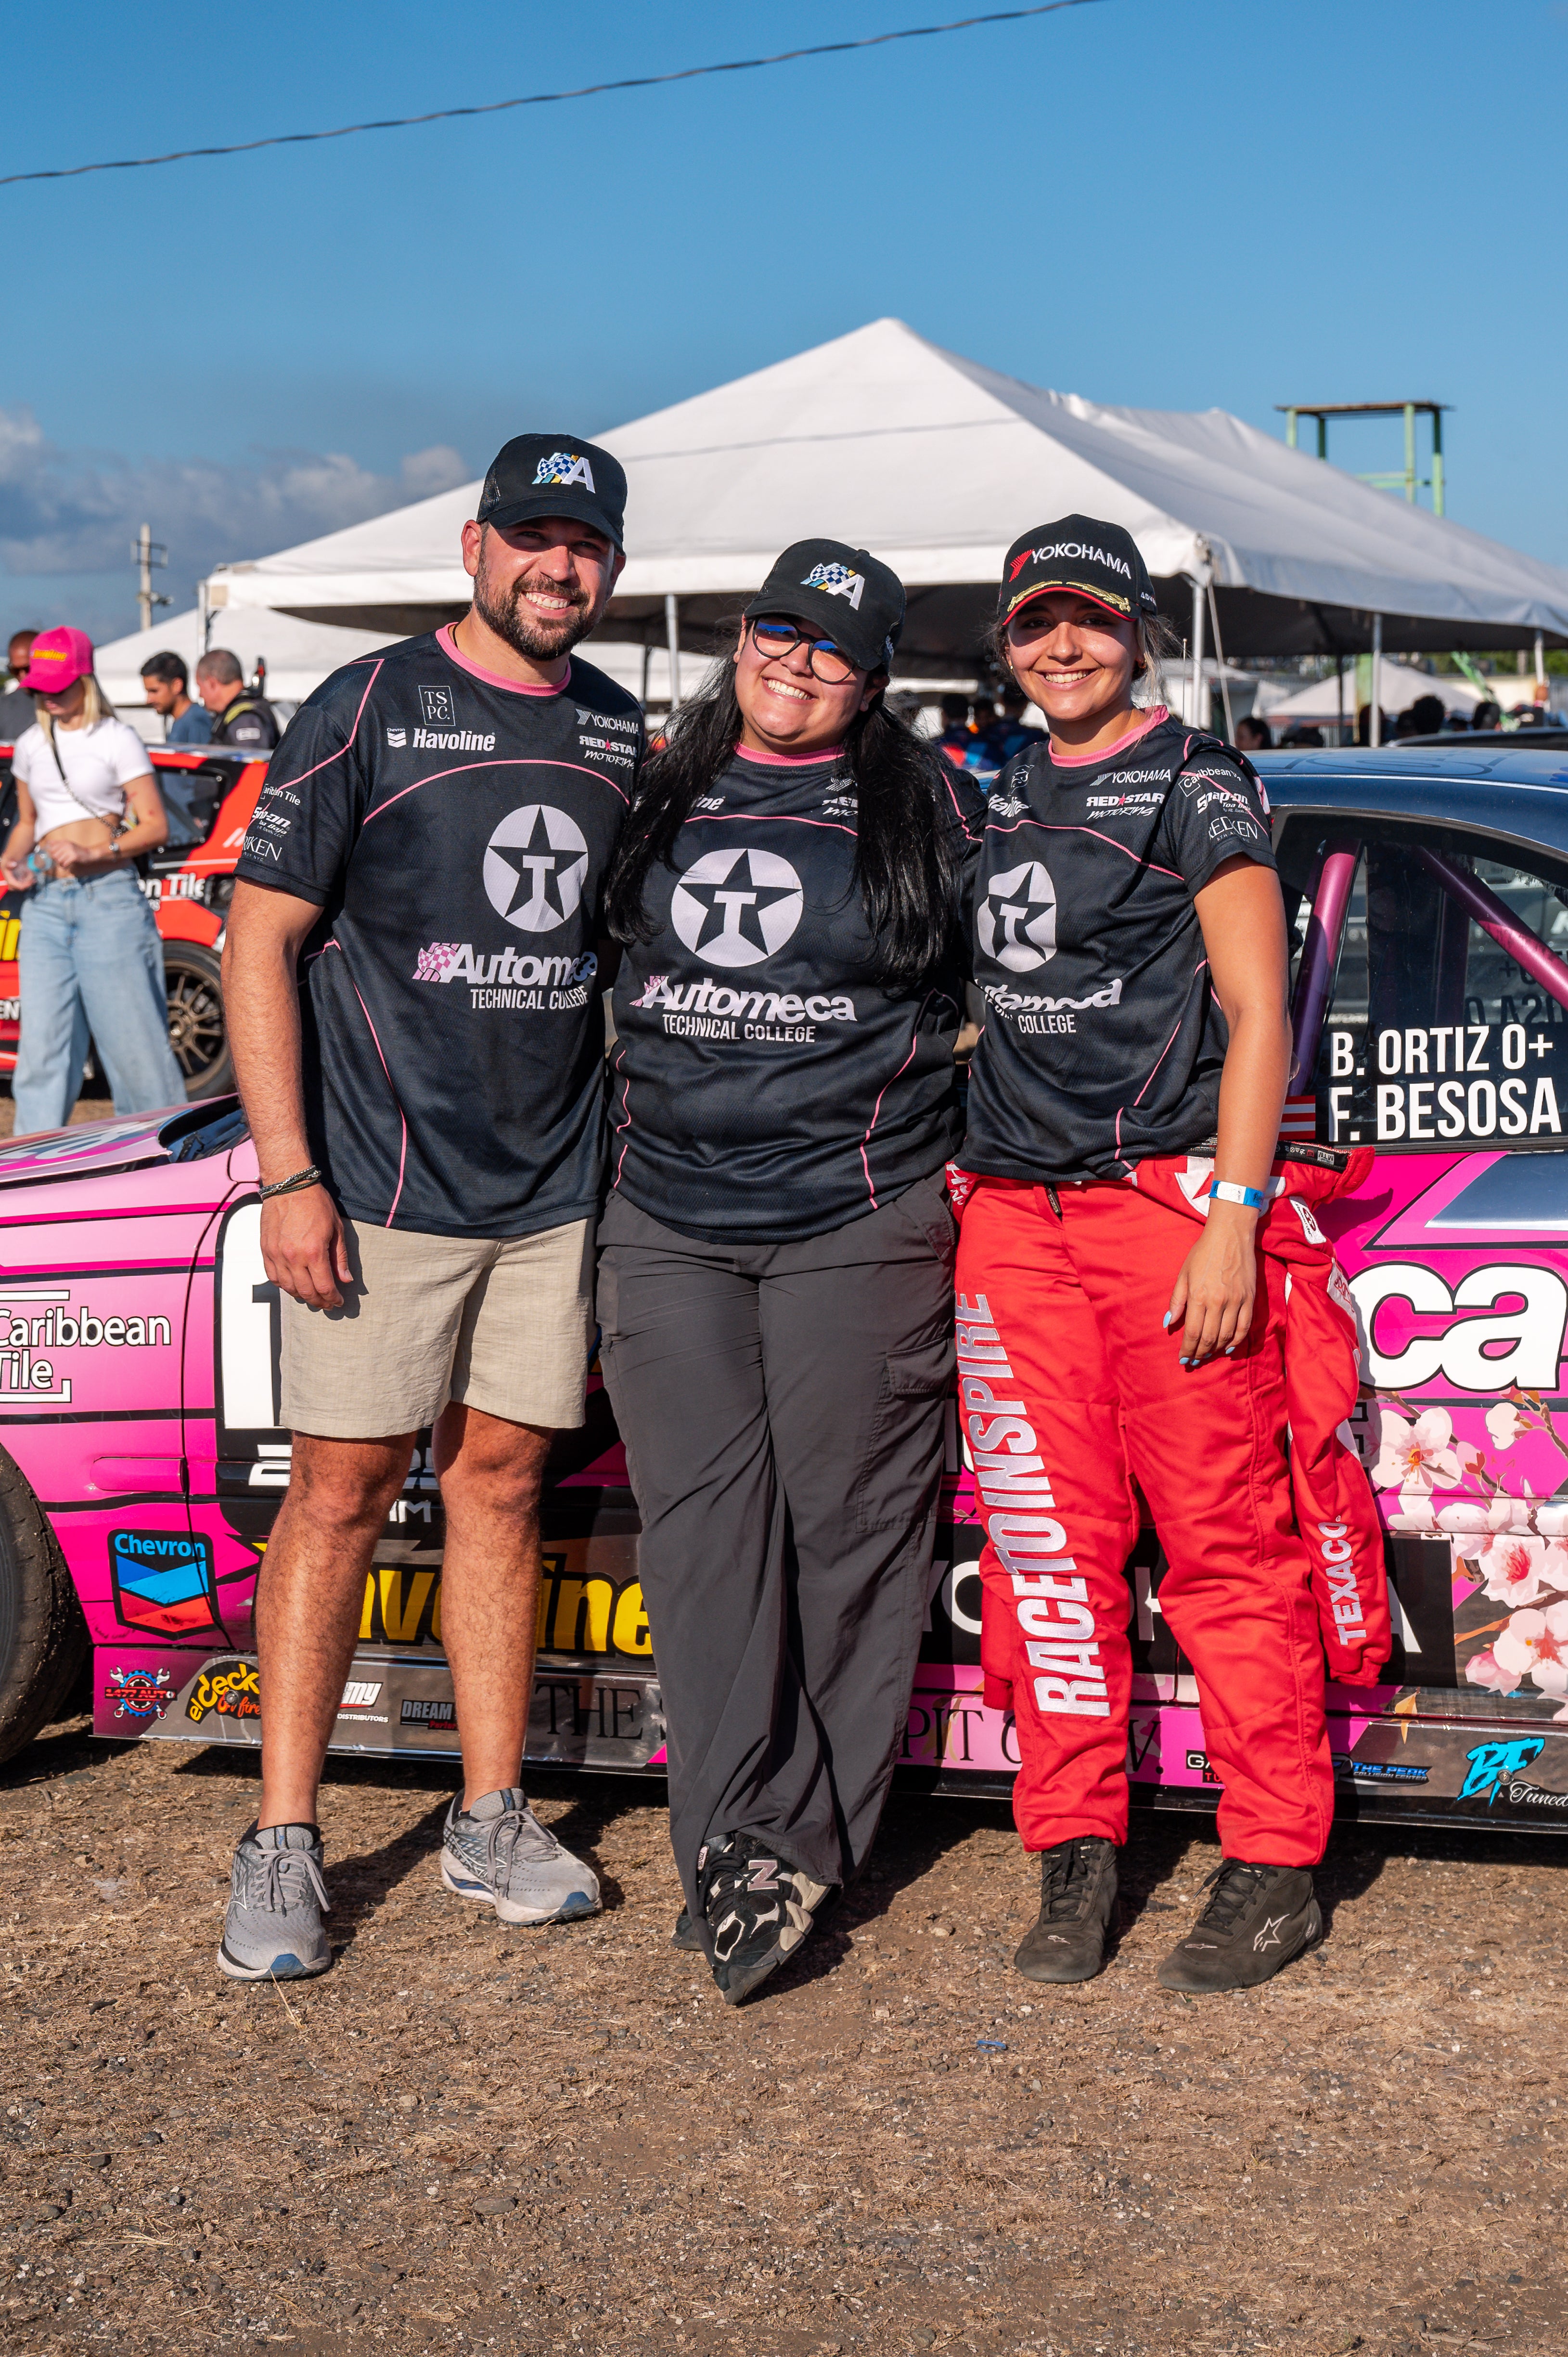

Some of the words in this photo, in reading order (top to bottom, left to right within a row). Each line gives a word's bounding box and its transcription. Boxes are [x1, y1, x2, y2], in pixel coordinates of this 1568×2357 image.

[1032, 543, 1132, 580] YOKOHAMA
[424, 691, 448, 704] TS
[426, 705, 450, 720] PC.
[591, 714, 640, 736] YOKOHAMA
[412, 728, 496, 751] Havoline
[1112, 769, 1171, 783] YOKOHAMA
[1183, 767, 1232, 788] Caribbean
[285, 791, 301, 805] Tile
[1086, 796, 1119, 807] RED
[1124, 792, 1165, 804] STAR
[1196, 791, 1248, 815] Snap-on
[1086, 806, 1156, 820] MOTORING
[267, 822, 288, 835] Baja
[470, 988, 545, 1010] TECHNICAL
[549, 985, 589, 1010] COLLEGE
[642, 976, 858, 1023] Automeca
[662, 1014, 740, 1040] TECHNICAL
[745, 1025, 816, 1043] COLLEGE
[1017, 1014, 1077, 1034] COLLEGE
[1331, 1031, 1365, 1077] B.
[1378, 1025, 1490, 1076] ORTIZ
[1328, 1086, 1361, 1142] F.
[1377, 1076, 1562, 1140] BESOSA
[114, 1533, 206, 1558] Chevron
[1317, 1521, 1368, 1646] TEXACO
[336, 1713, 389, 1723] DISTRIBUTORS
[401, 1700, 453, 1720] DREAM
[535, 1684, 644, 1740] THE
[1352, 1762, 1383, 1773] THE
[1386, 1766, 1428, 1777] PEAK
